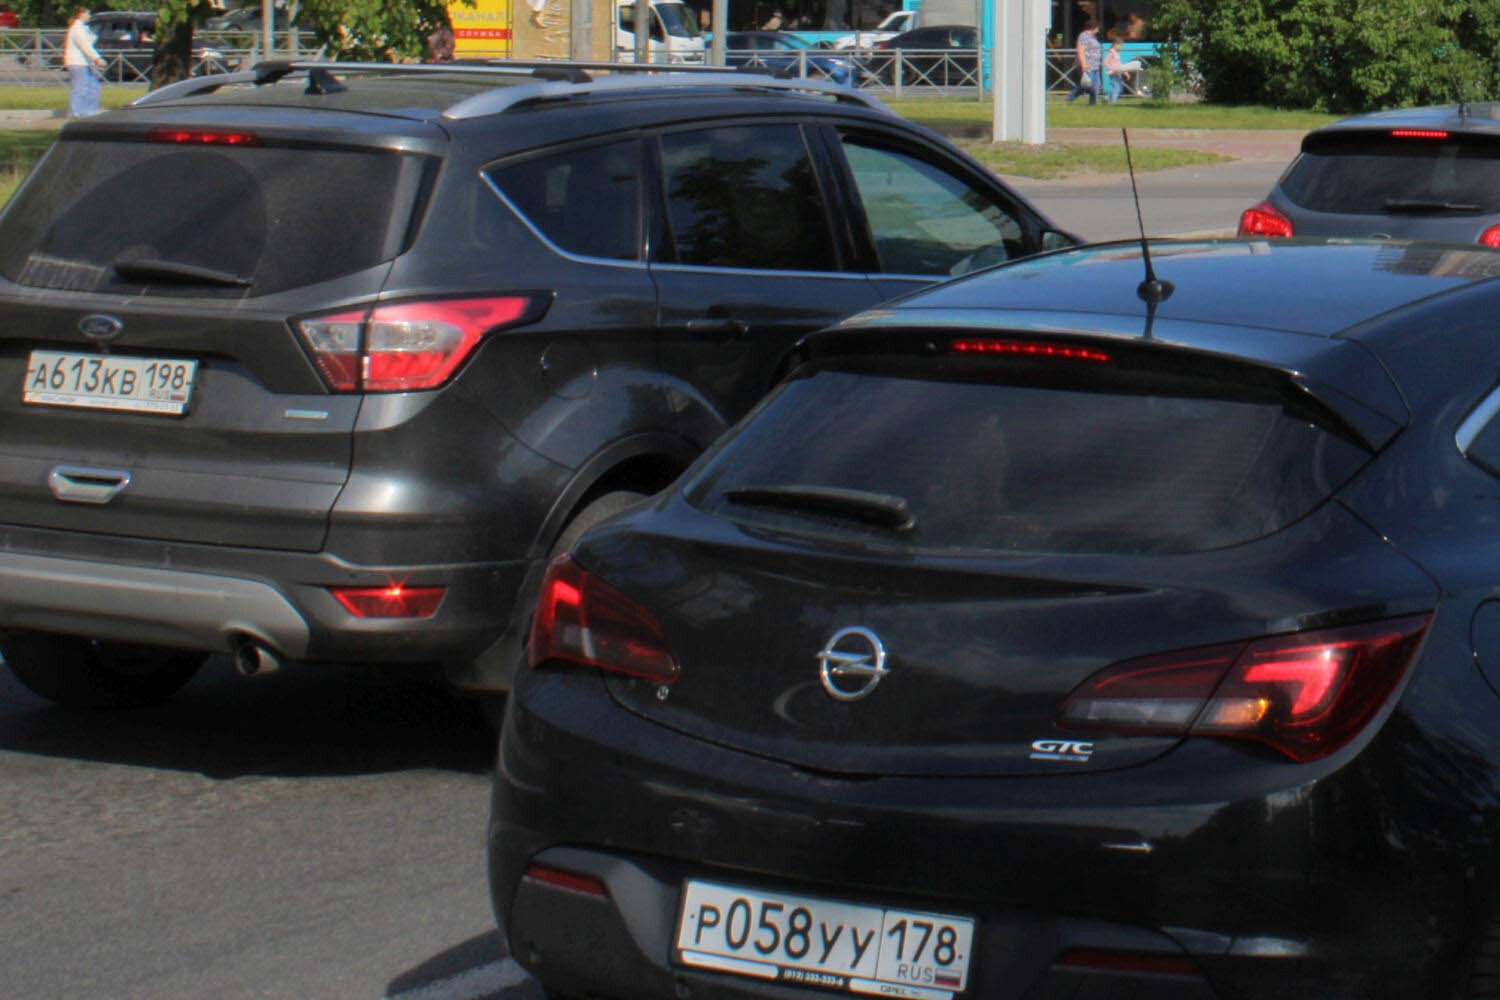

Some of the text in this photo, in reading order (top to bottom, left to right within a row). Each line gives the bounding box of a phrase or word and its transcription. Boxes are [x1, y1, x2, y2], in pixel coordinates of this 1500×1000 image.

[33, 356, 186, 395] А613КВ 198
[1031, 740, 1094, 754] GTC
[695, 897, 957, 969] Р058УУ 178
[897, 963, 934, 983] RUS
